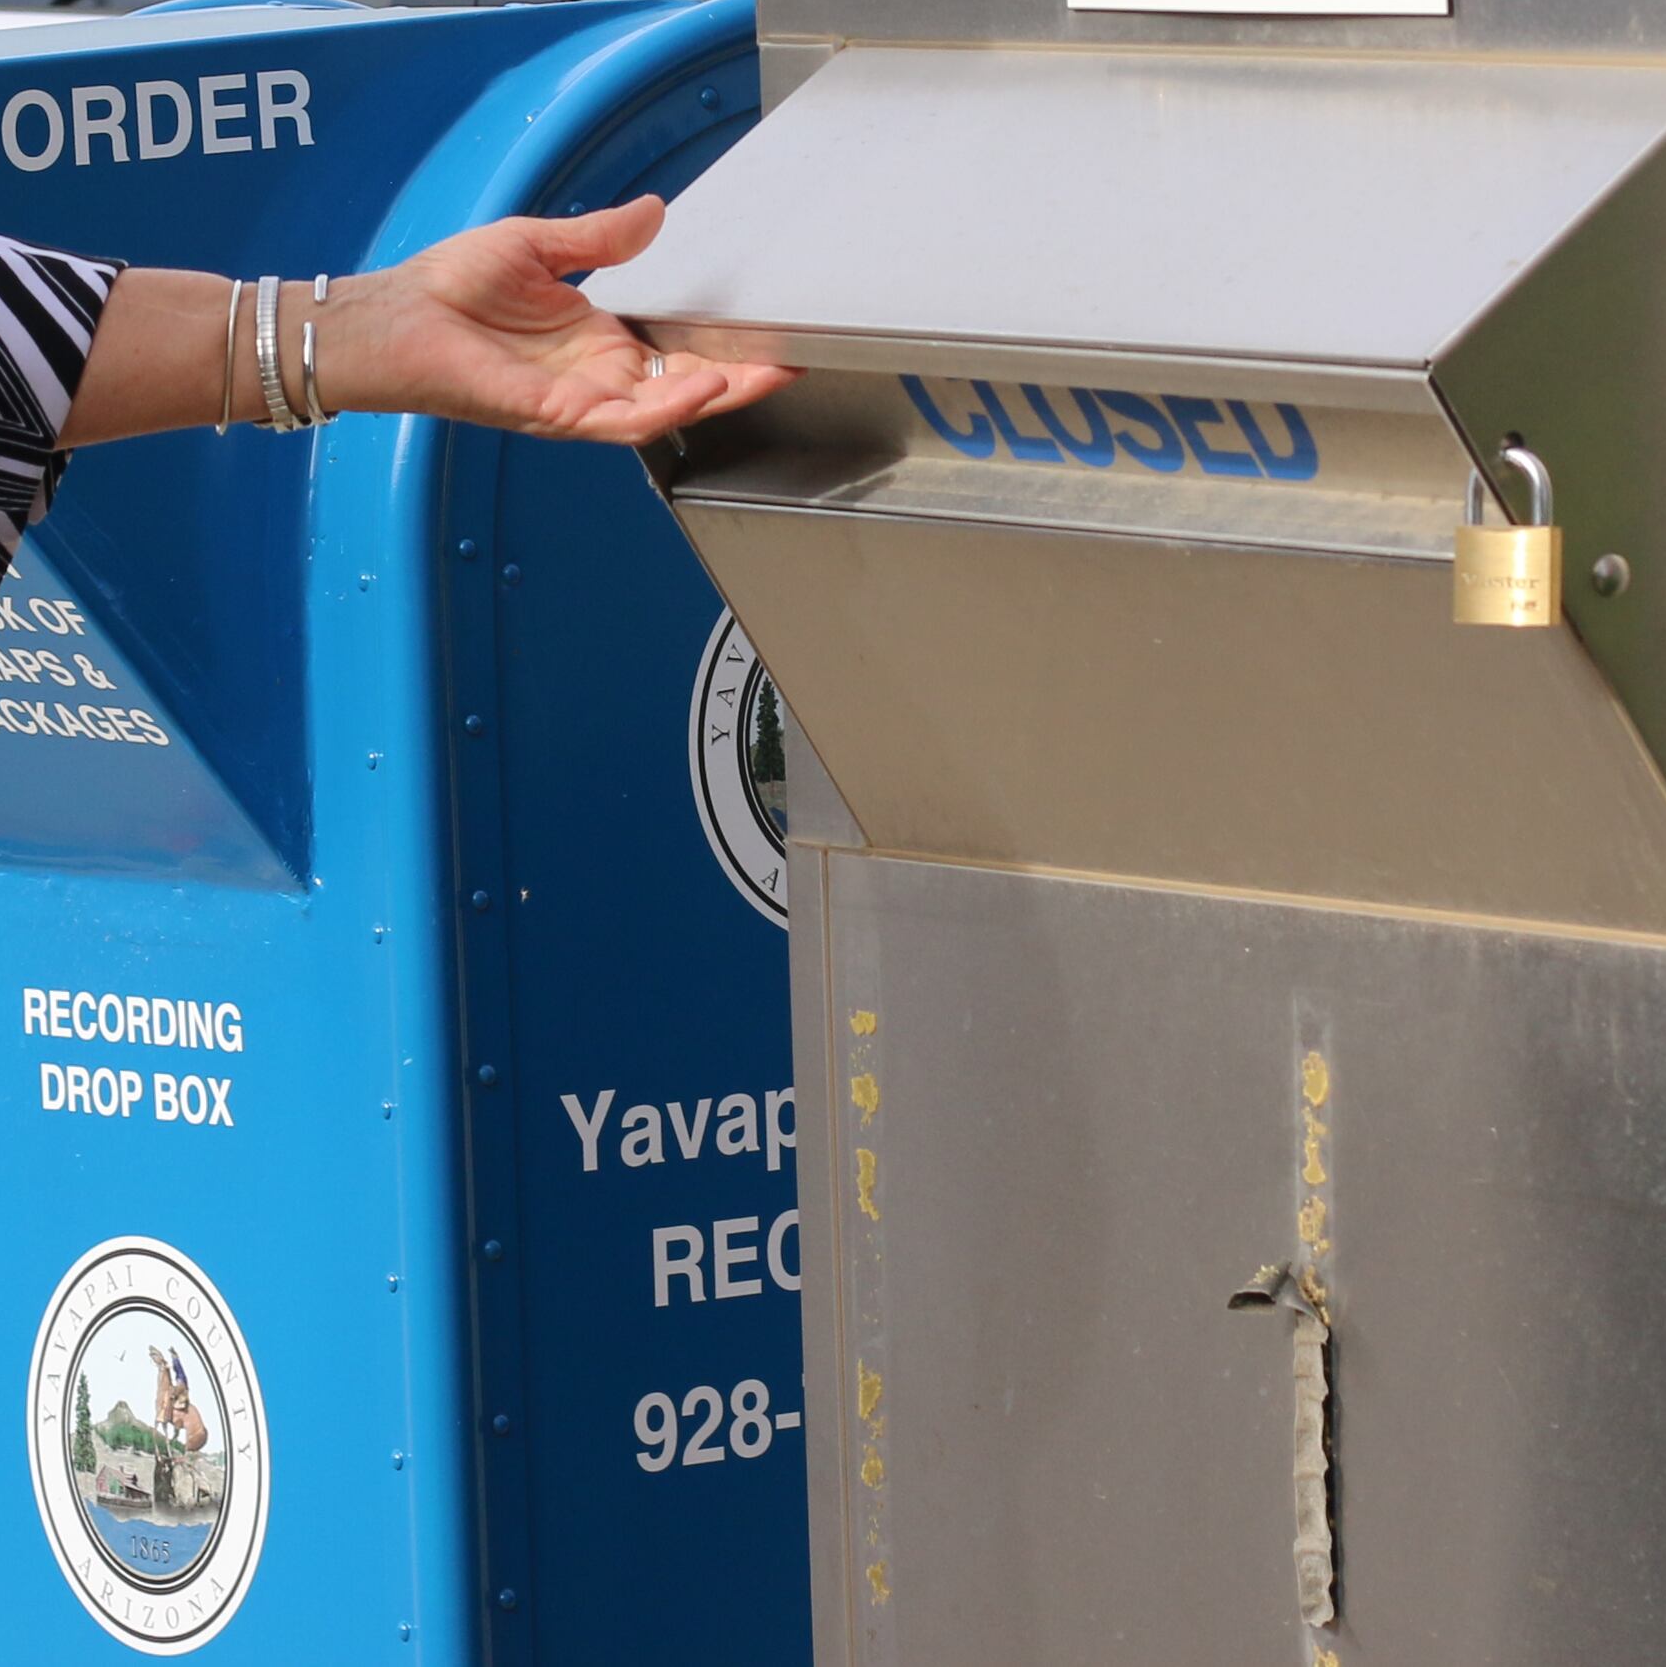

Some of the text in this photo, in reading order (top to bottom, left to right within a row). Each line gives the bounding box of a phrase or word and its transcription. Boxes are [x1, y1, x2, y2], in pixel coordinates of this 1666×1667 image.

[29, 597, 86, 636] OF
[73, 653, 117, 690] &
[23, 987, 244, 1053] RECORDING
[40, 1062, 234, 1127] DROP BOX
[42, 1264, 253, 1462] YAVAPAI COUNTY
[129, 1535, 171, 1565] 1865
[77, 1556, 226, 1631] ARIZONA
